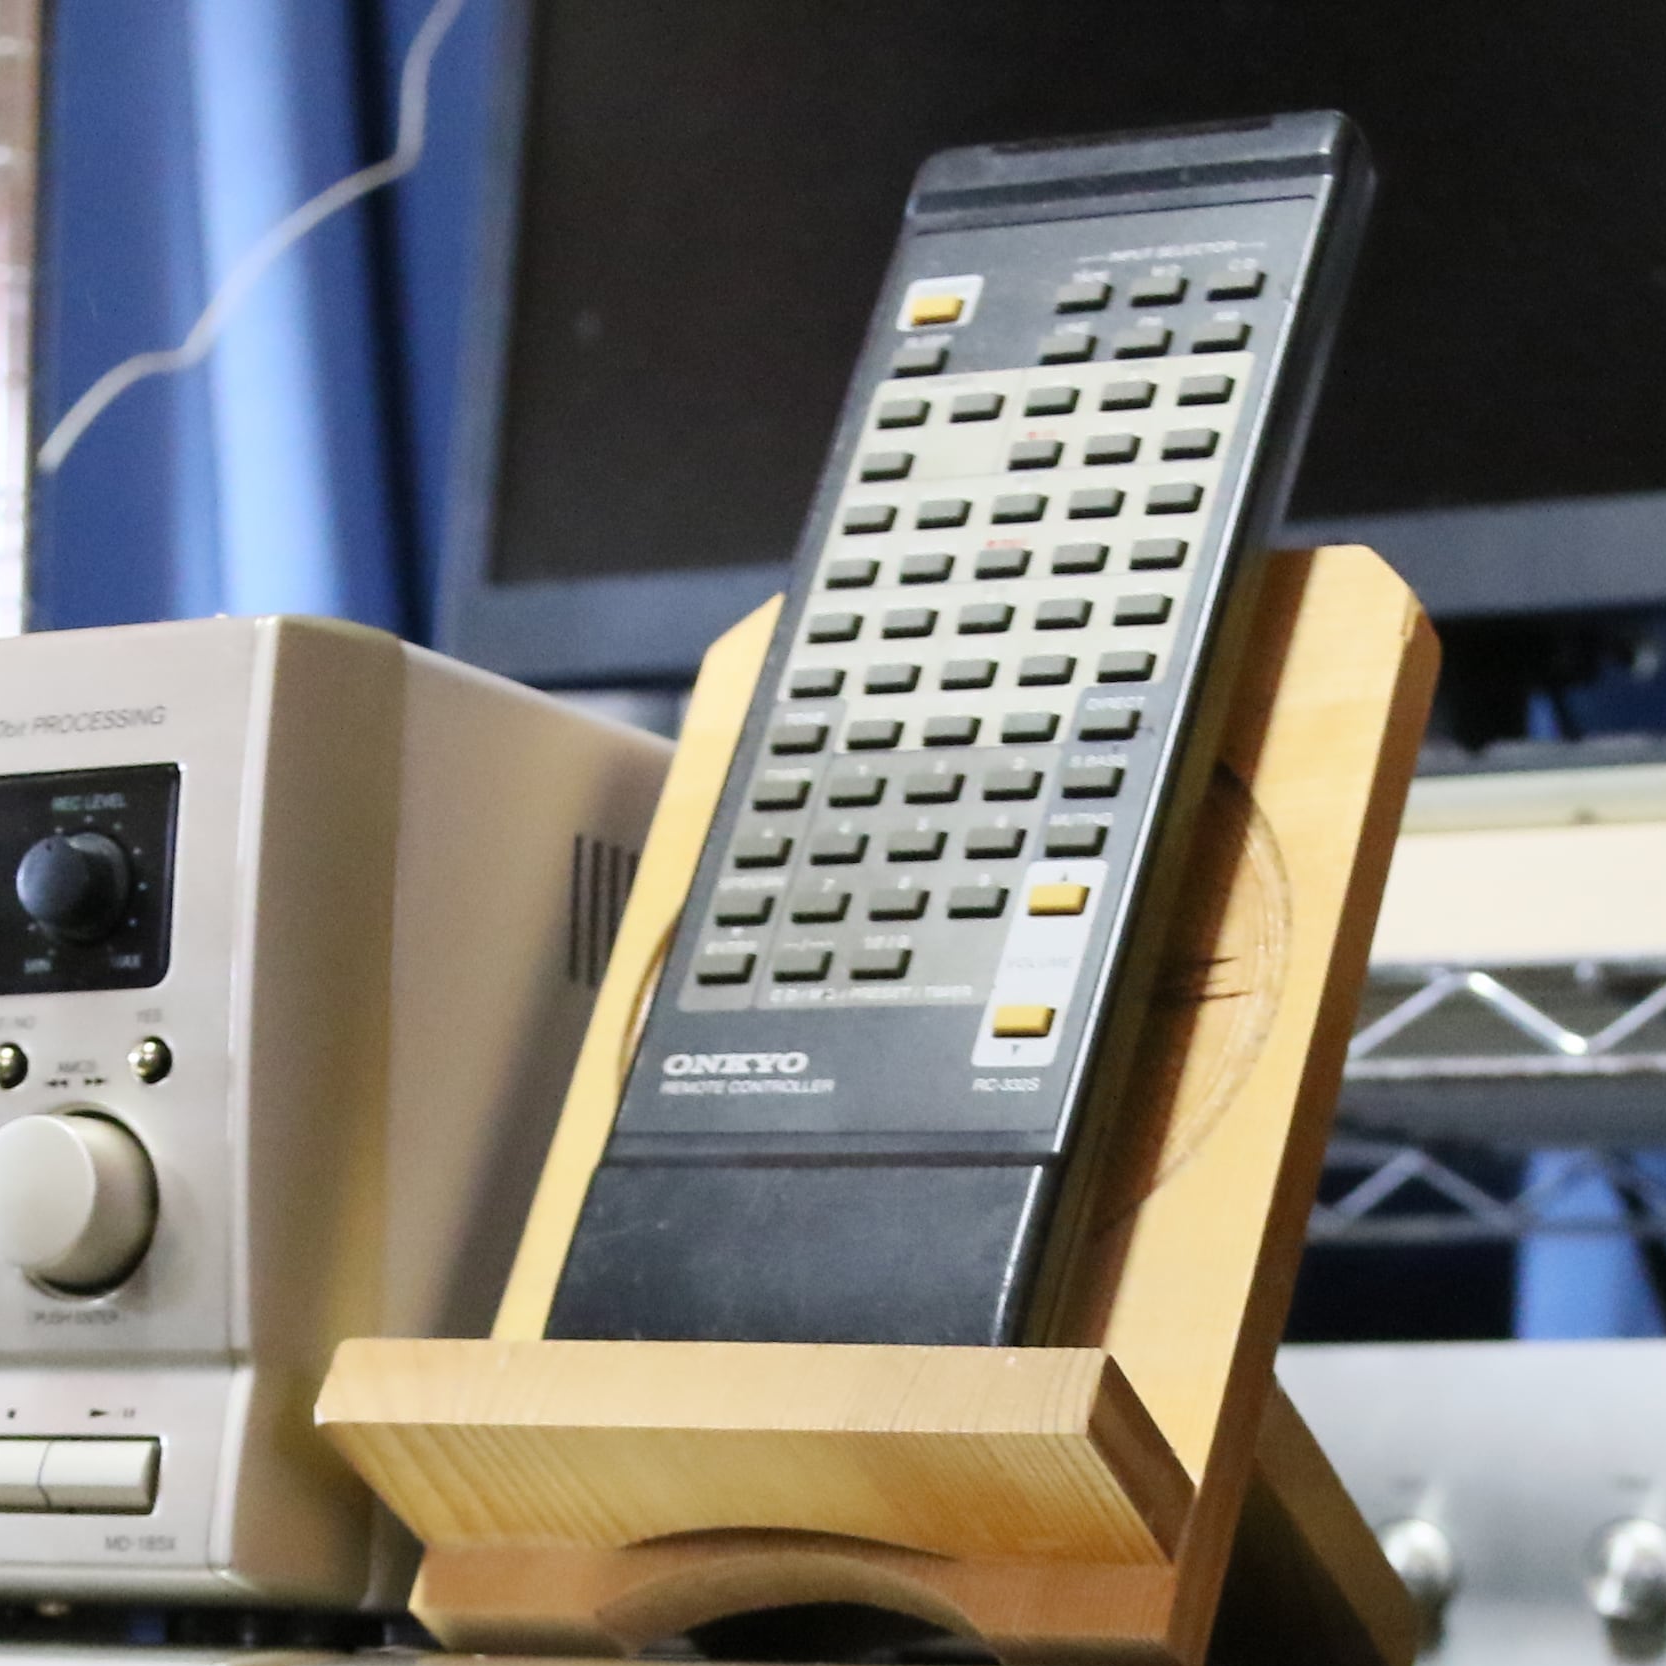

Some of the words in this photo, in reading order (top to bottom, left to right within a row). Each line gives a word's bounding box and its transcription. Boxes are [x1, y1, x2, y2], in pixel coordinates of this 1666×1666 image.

[32, 705, 166, 735] PROCESSING
[661, 1052, 810, 1077] ONKYO
[728, 1077, 836, 1095] CONTROLLER
